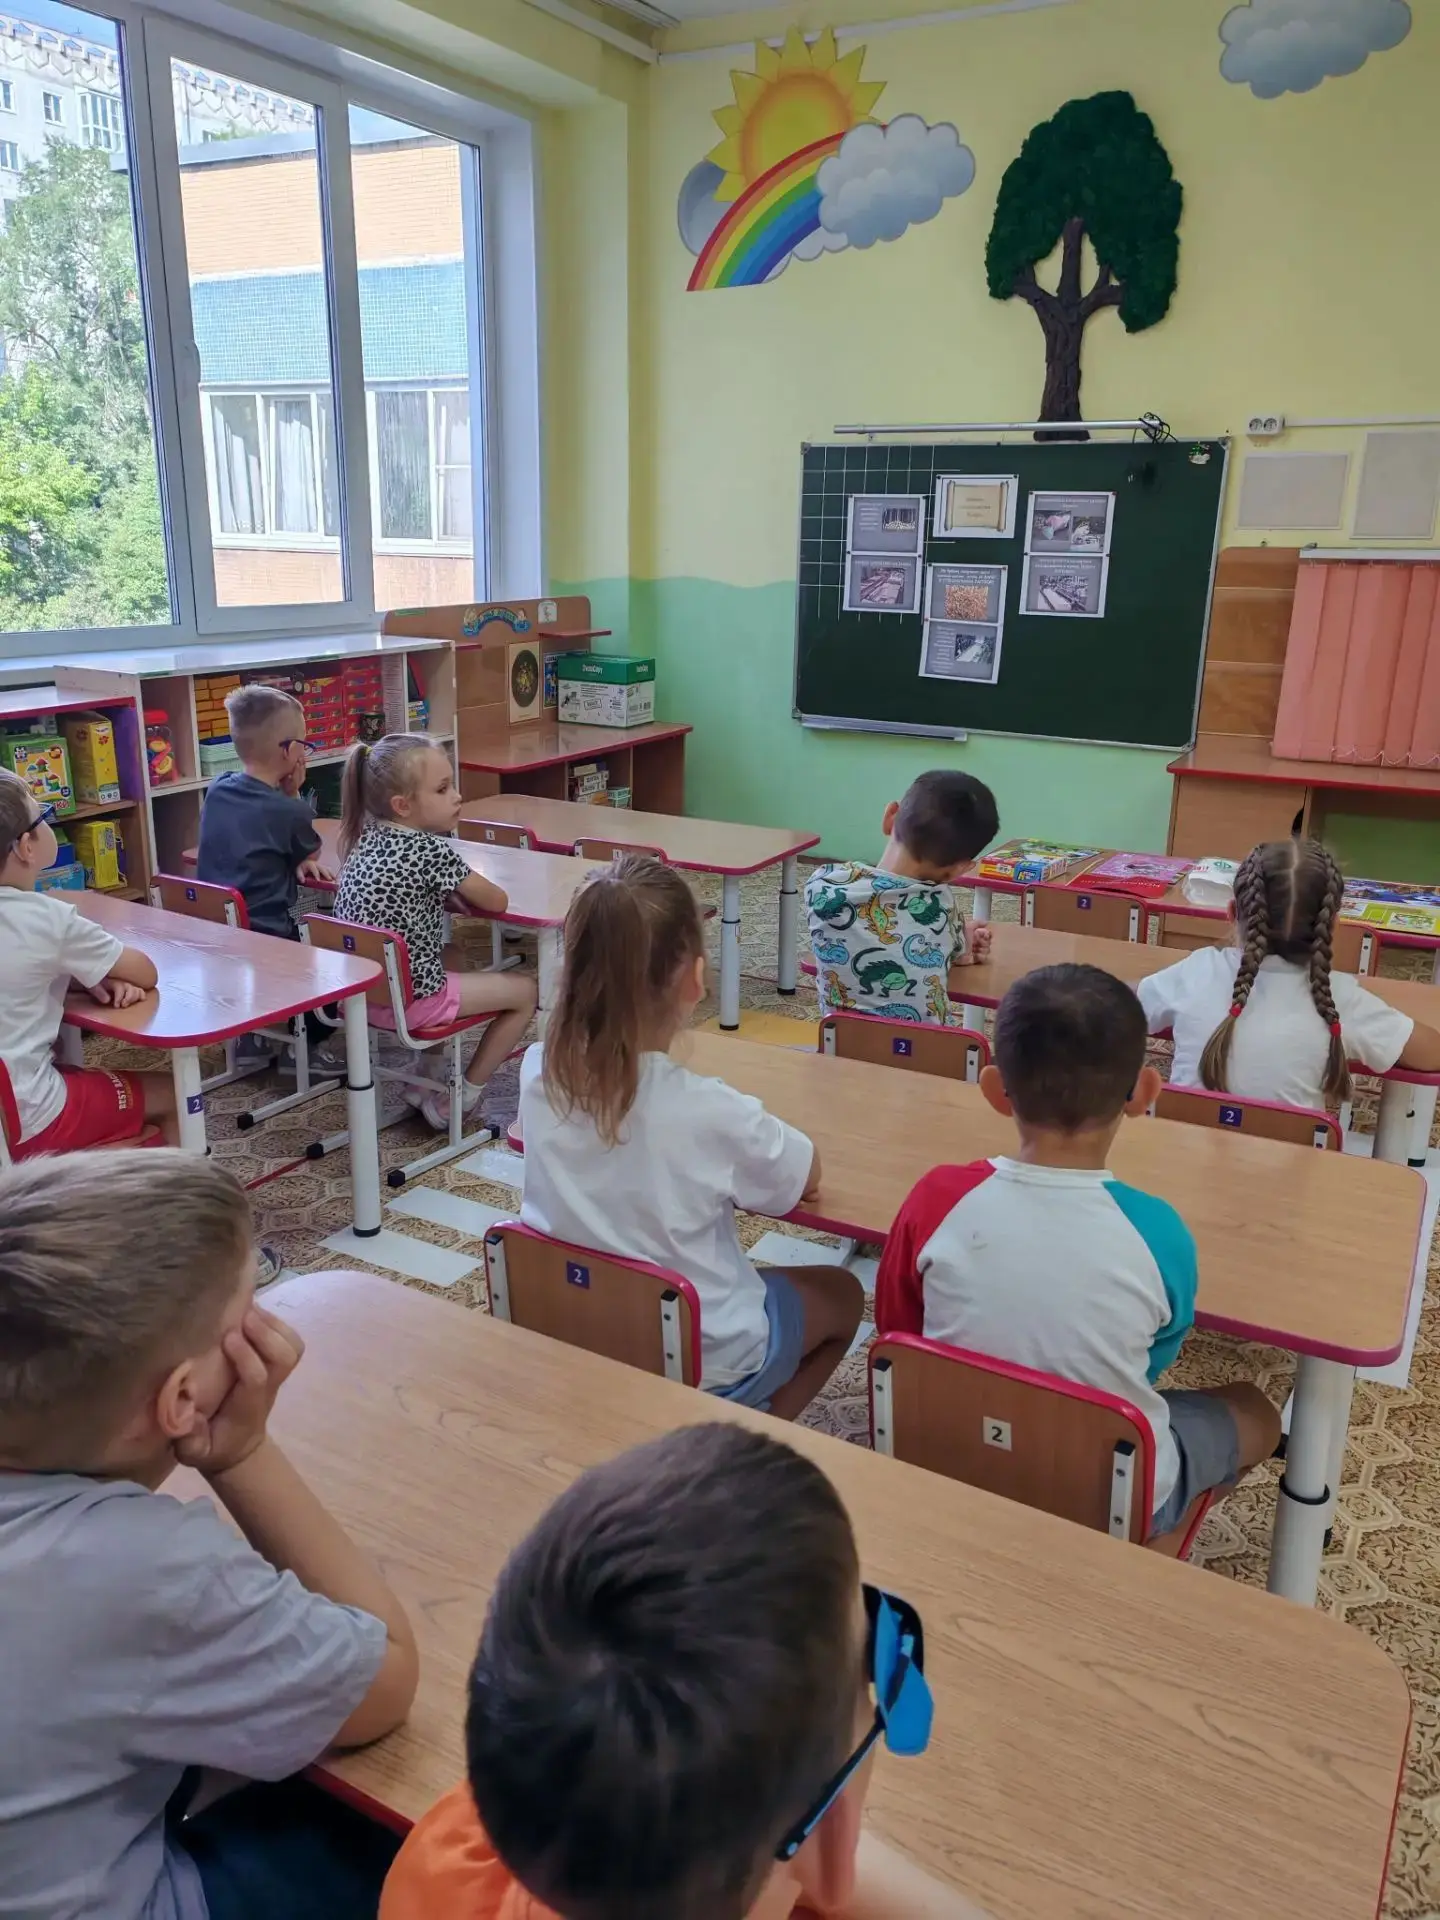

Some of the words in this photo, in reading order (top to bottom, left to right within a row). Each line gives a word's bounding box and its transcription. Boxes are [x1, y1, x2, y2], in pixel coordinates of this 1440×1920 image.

[1081, 898, 1087, 908] 2
[899, 1041, 906, 1053] 2
[117, 1090, 127, 1110] BEST
[193, 1099, 201, 1111] 2
[1225, 1110, 1235, 1123] 2
[573, 1268, 582, 1284] 2
[991, 1426, 1003, 1443] 2
